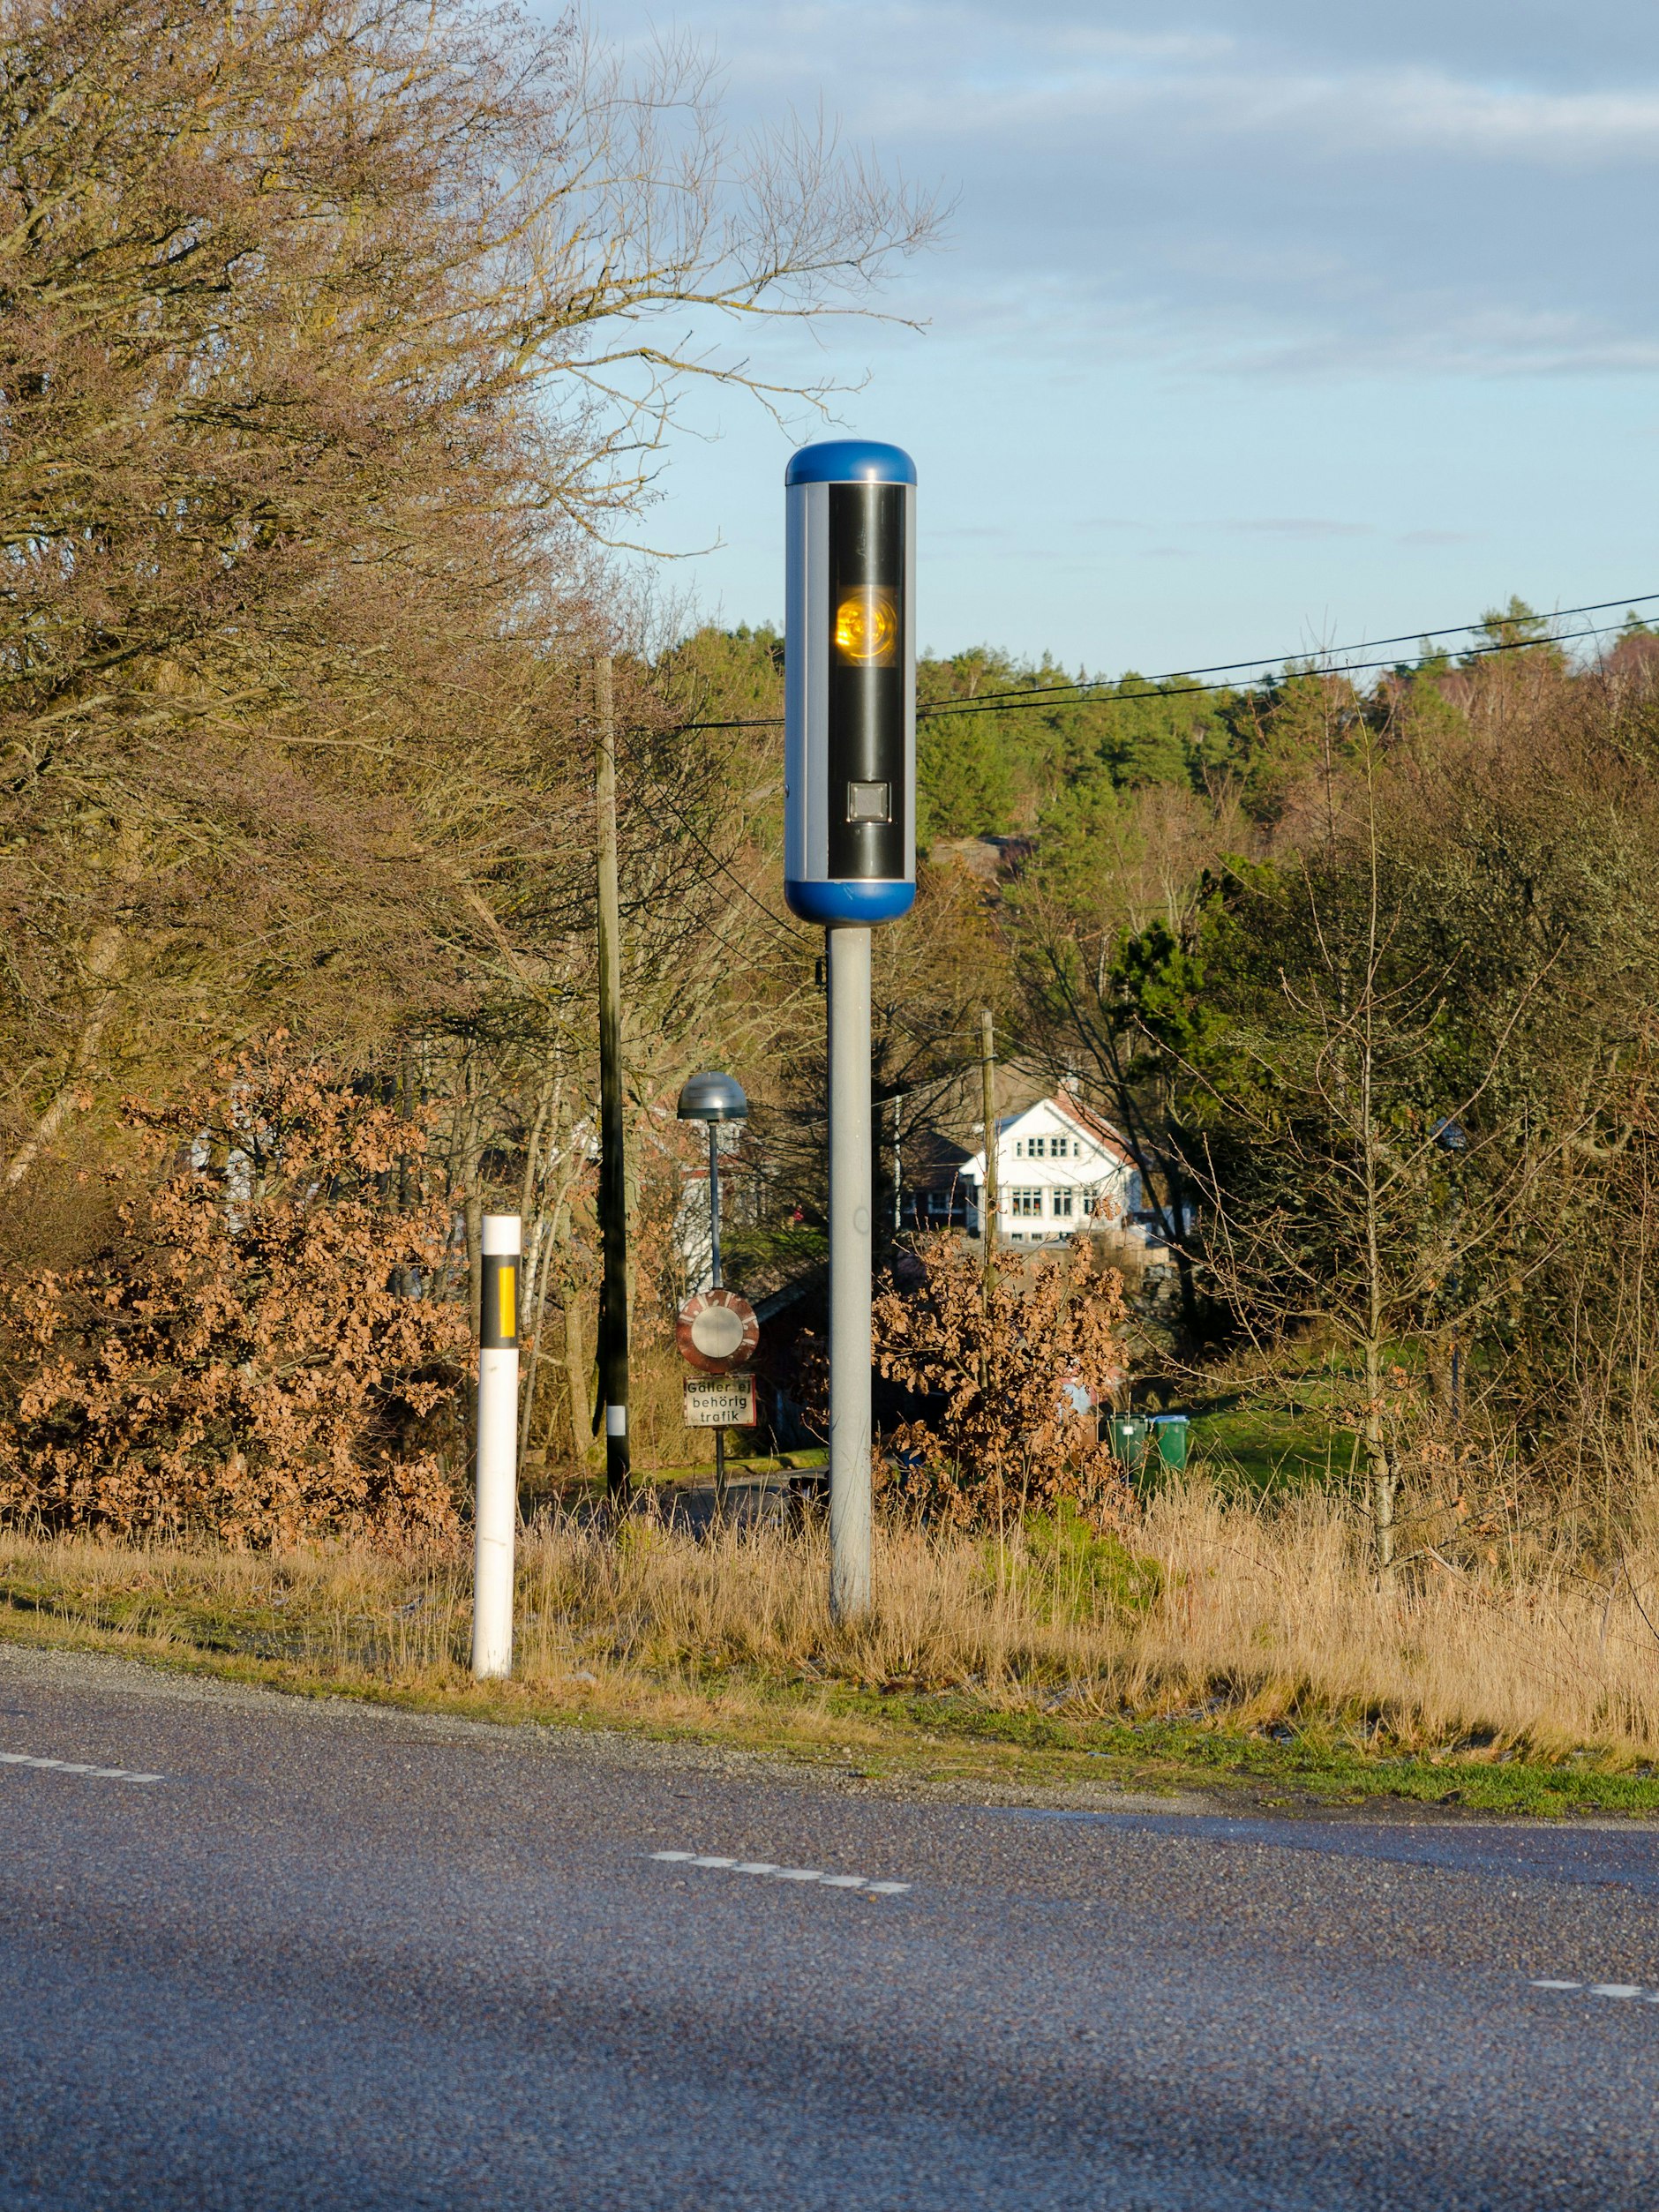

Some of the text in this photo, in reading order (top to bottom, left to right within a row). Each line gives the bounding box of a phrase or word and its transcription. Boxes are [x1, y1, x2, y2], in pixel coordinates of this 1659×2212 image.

[687, 1380, 751, 1394] Gäller ej
[693, 1395, 747, 1409] behörig
[701, 1411, 739, 1422] trafik
